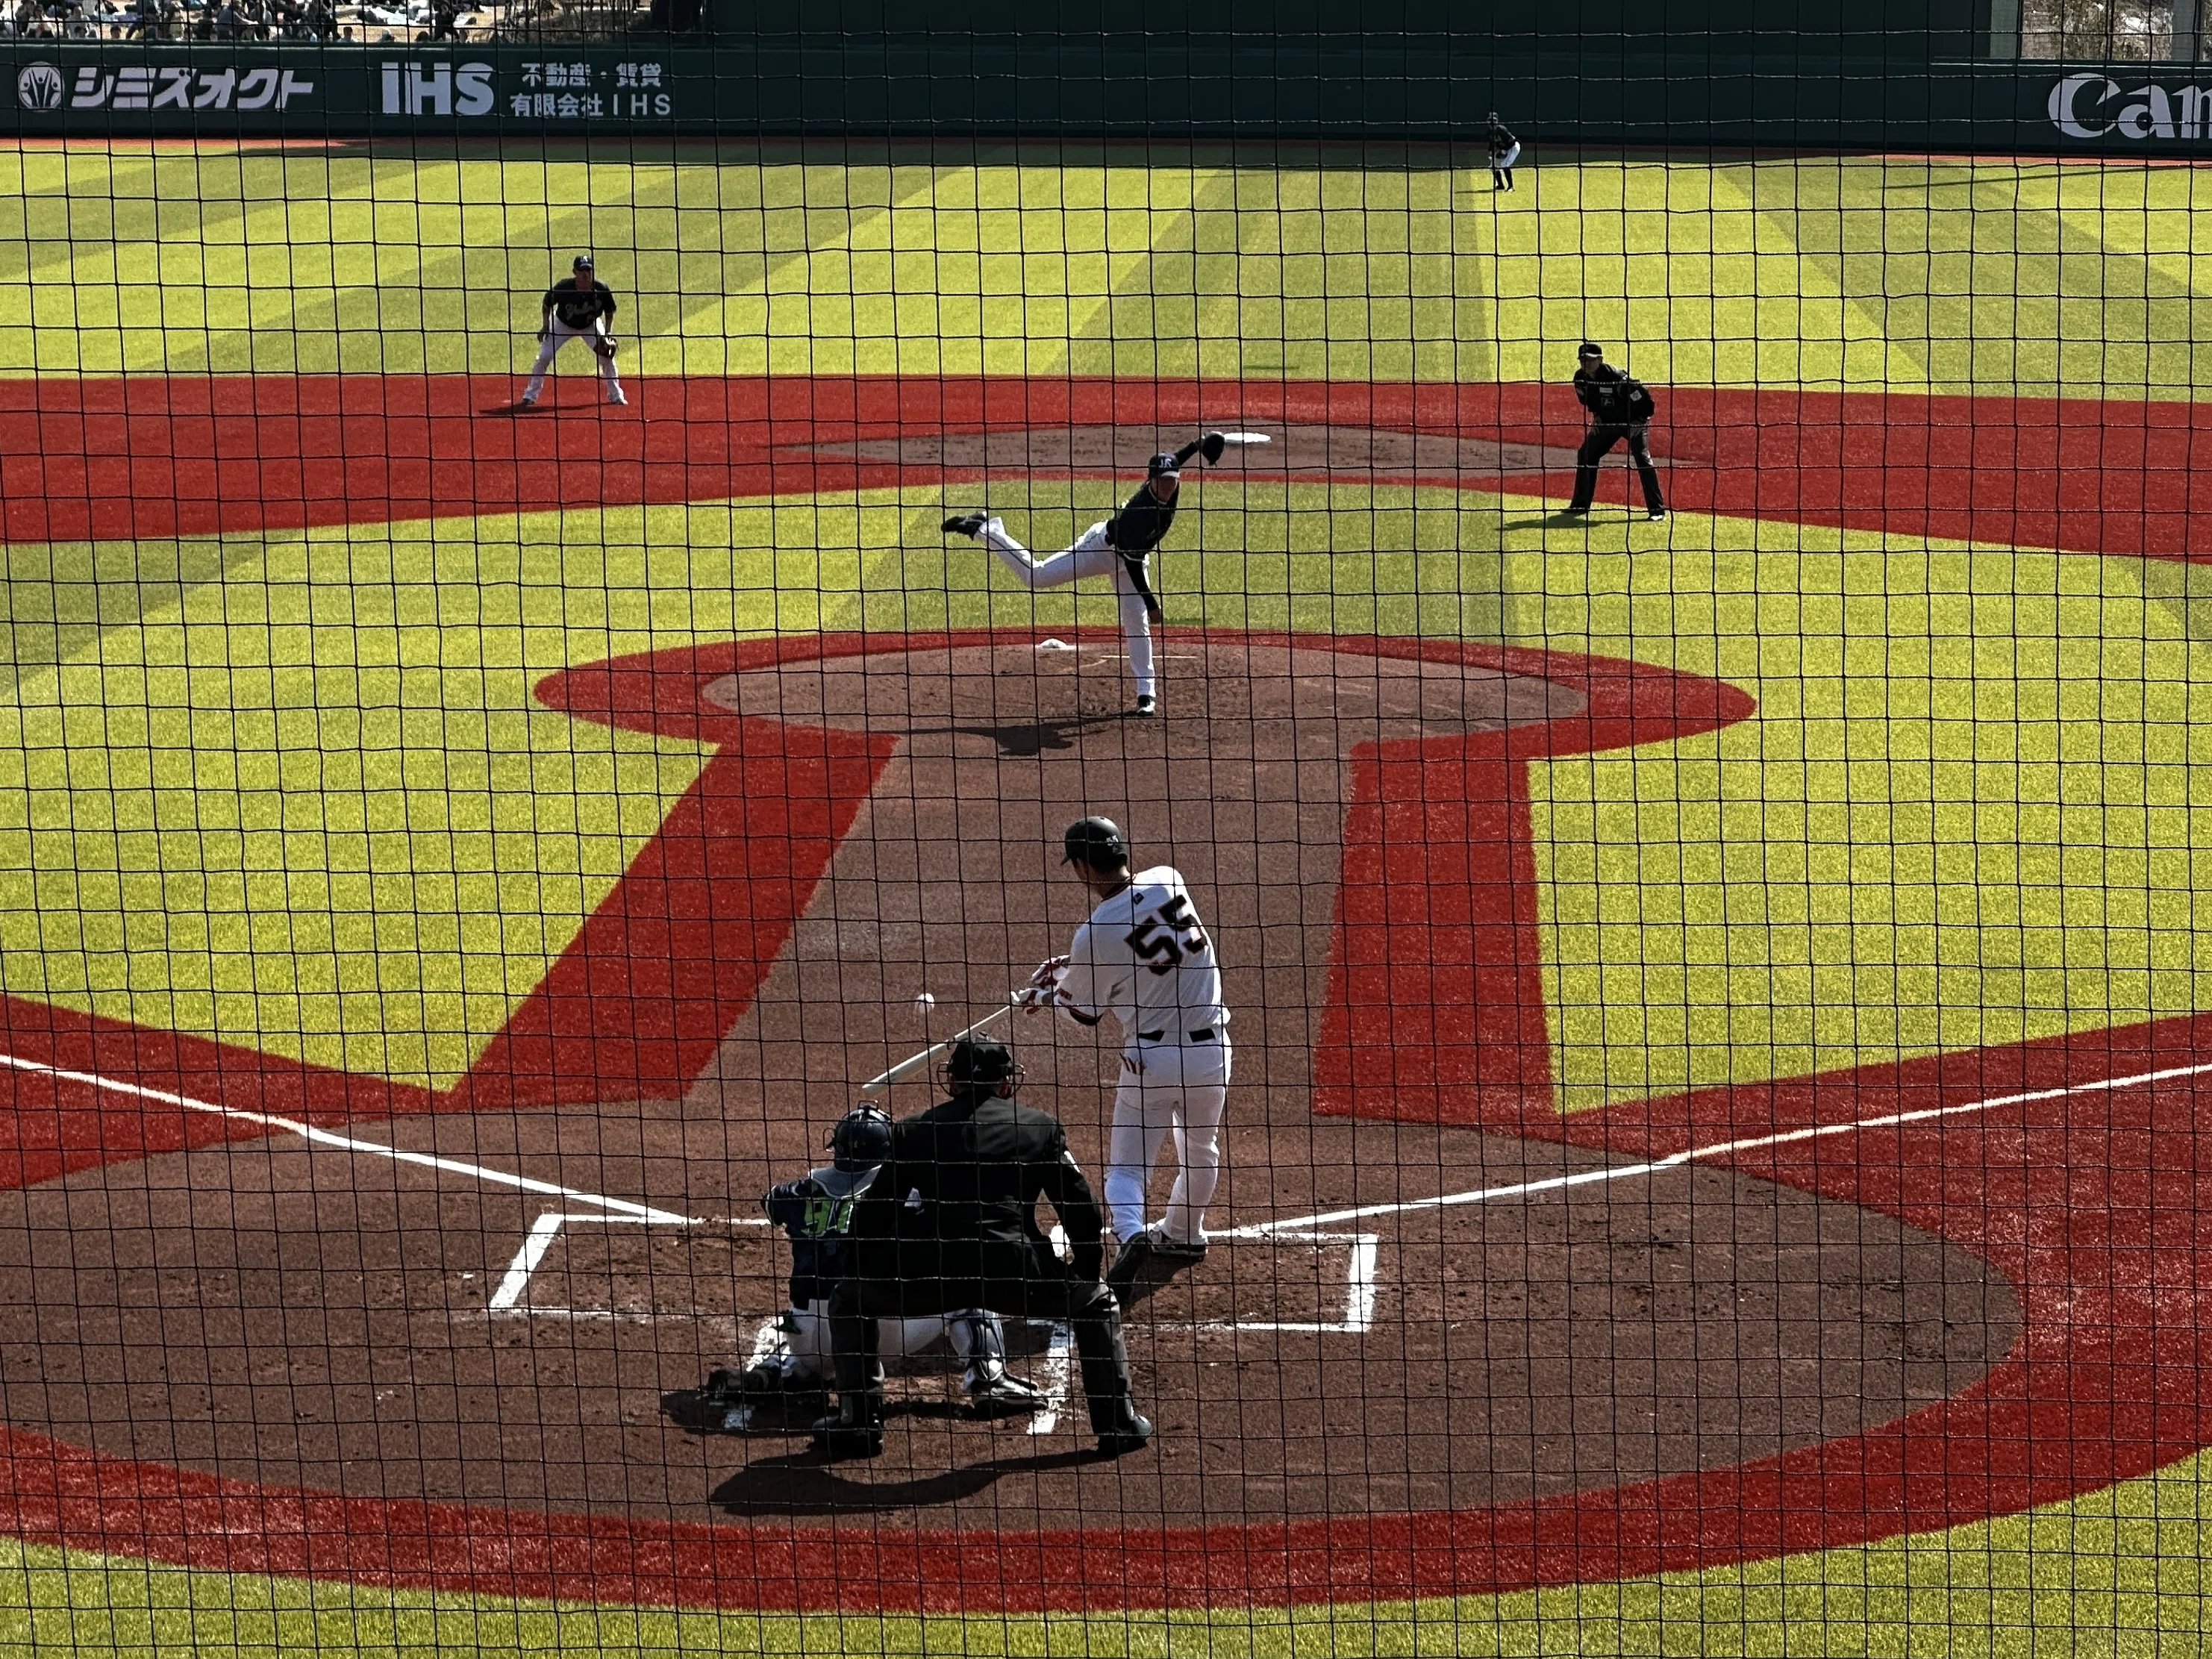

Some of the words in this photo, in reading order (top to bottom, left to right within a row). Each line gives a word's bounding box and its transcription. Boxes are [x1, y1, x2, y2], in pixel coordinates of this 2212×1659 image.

[71, 66, 313, 110] シミズオクト
[381, 62, 494, 116] IHS
[521, 62, 662, 87] 不動産・賃貸
[1123, 894, 1209, 977] 55
